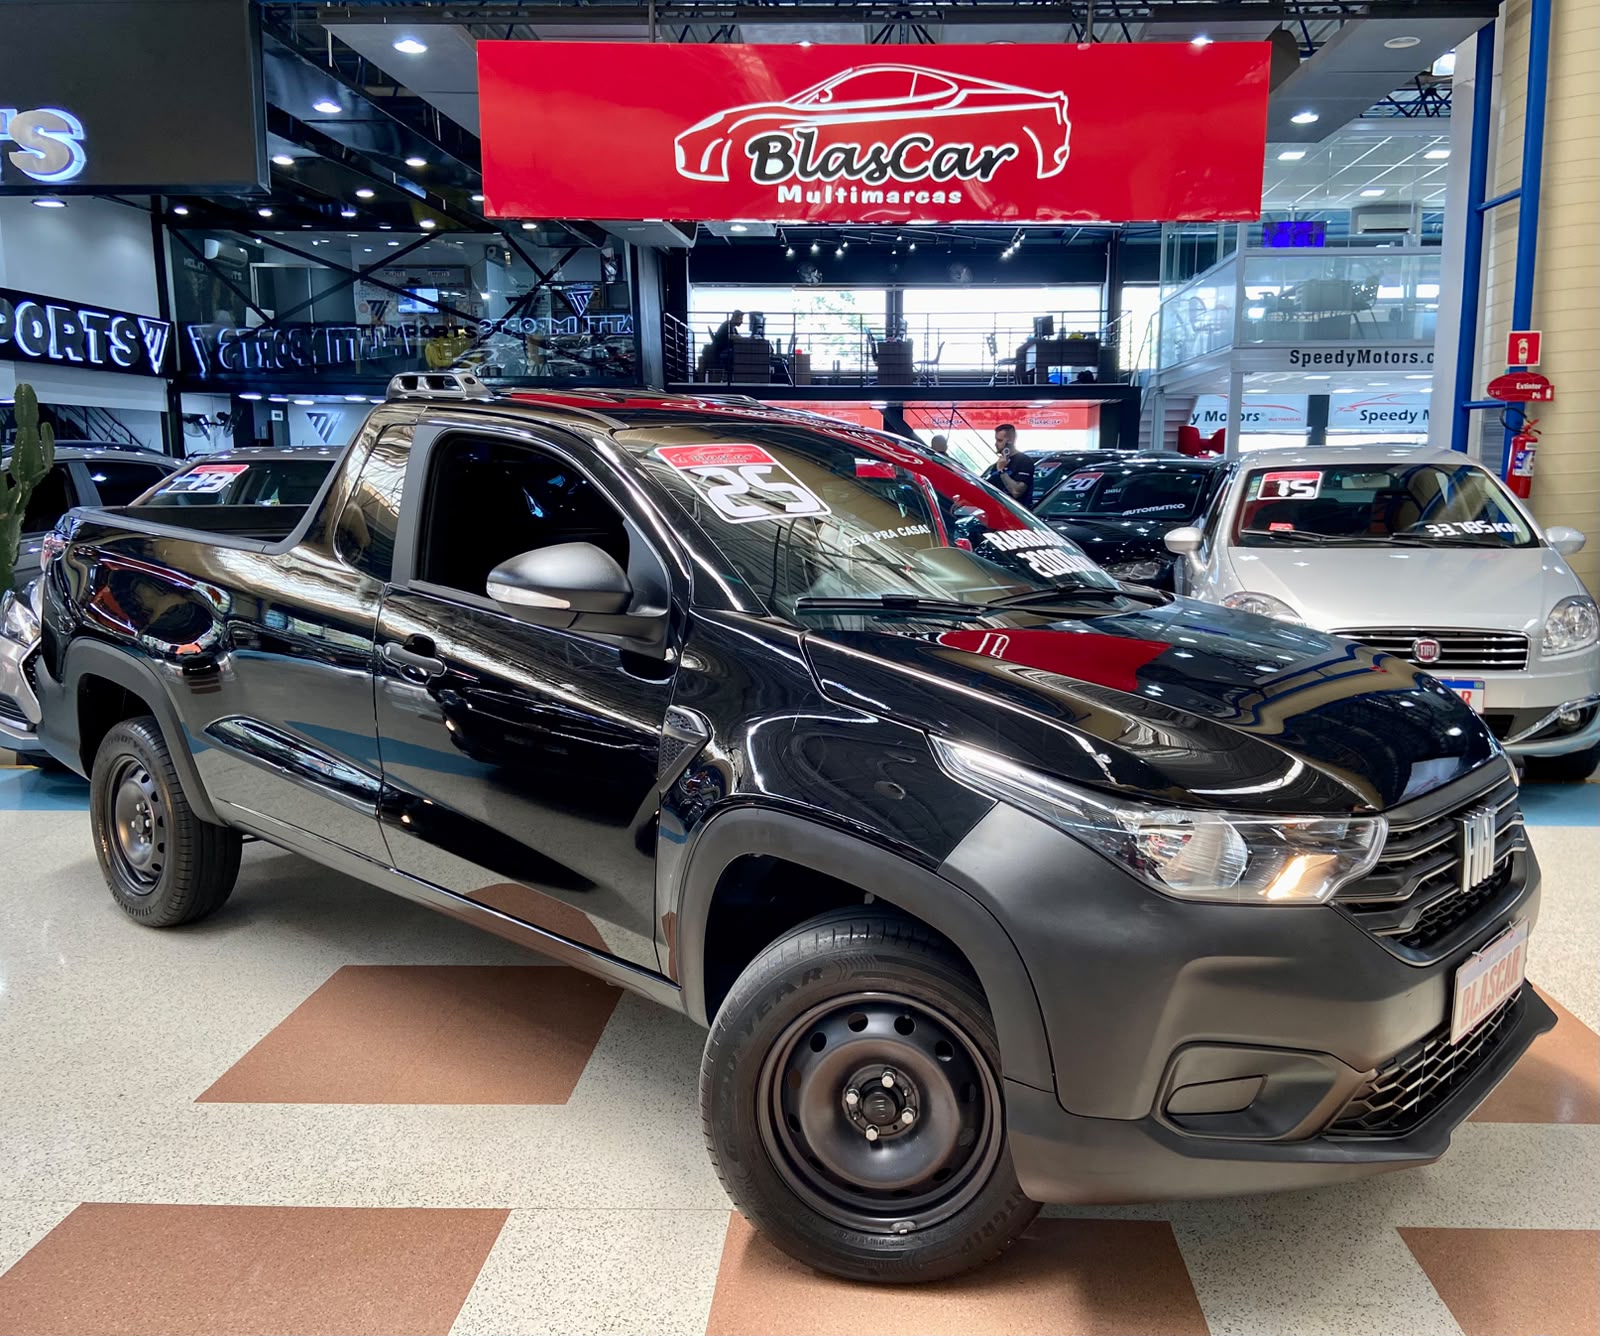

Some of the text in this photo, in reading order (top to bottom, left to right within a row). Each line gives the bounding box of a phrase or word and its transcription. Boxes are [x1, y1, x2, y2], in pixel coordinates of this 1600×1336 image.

[747, 127, 1018, 184] BlasCar
[777, 185, 963, 204] Multimarcas
[1360, 409, 1418, 424] Speedy
[690, 466, 821, 518] 25
[1065, 478, 1095, 491] 20
[1277, 480, 1315, 497] 15
[842, 524, 931, 548] LEVA PRA CASA!
[1420, 645, 1435, 656] FIAT
[1462, 804, 1497, 894] FIAT
